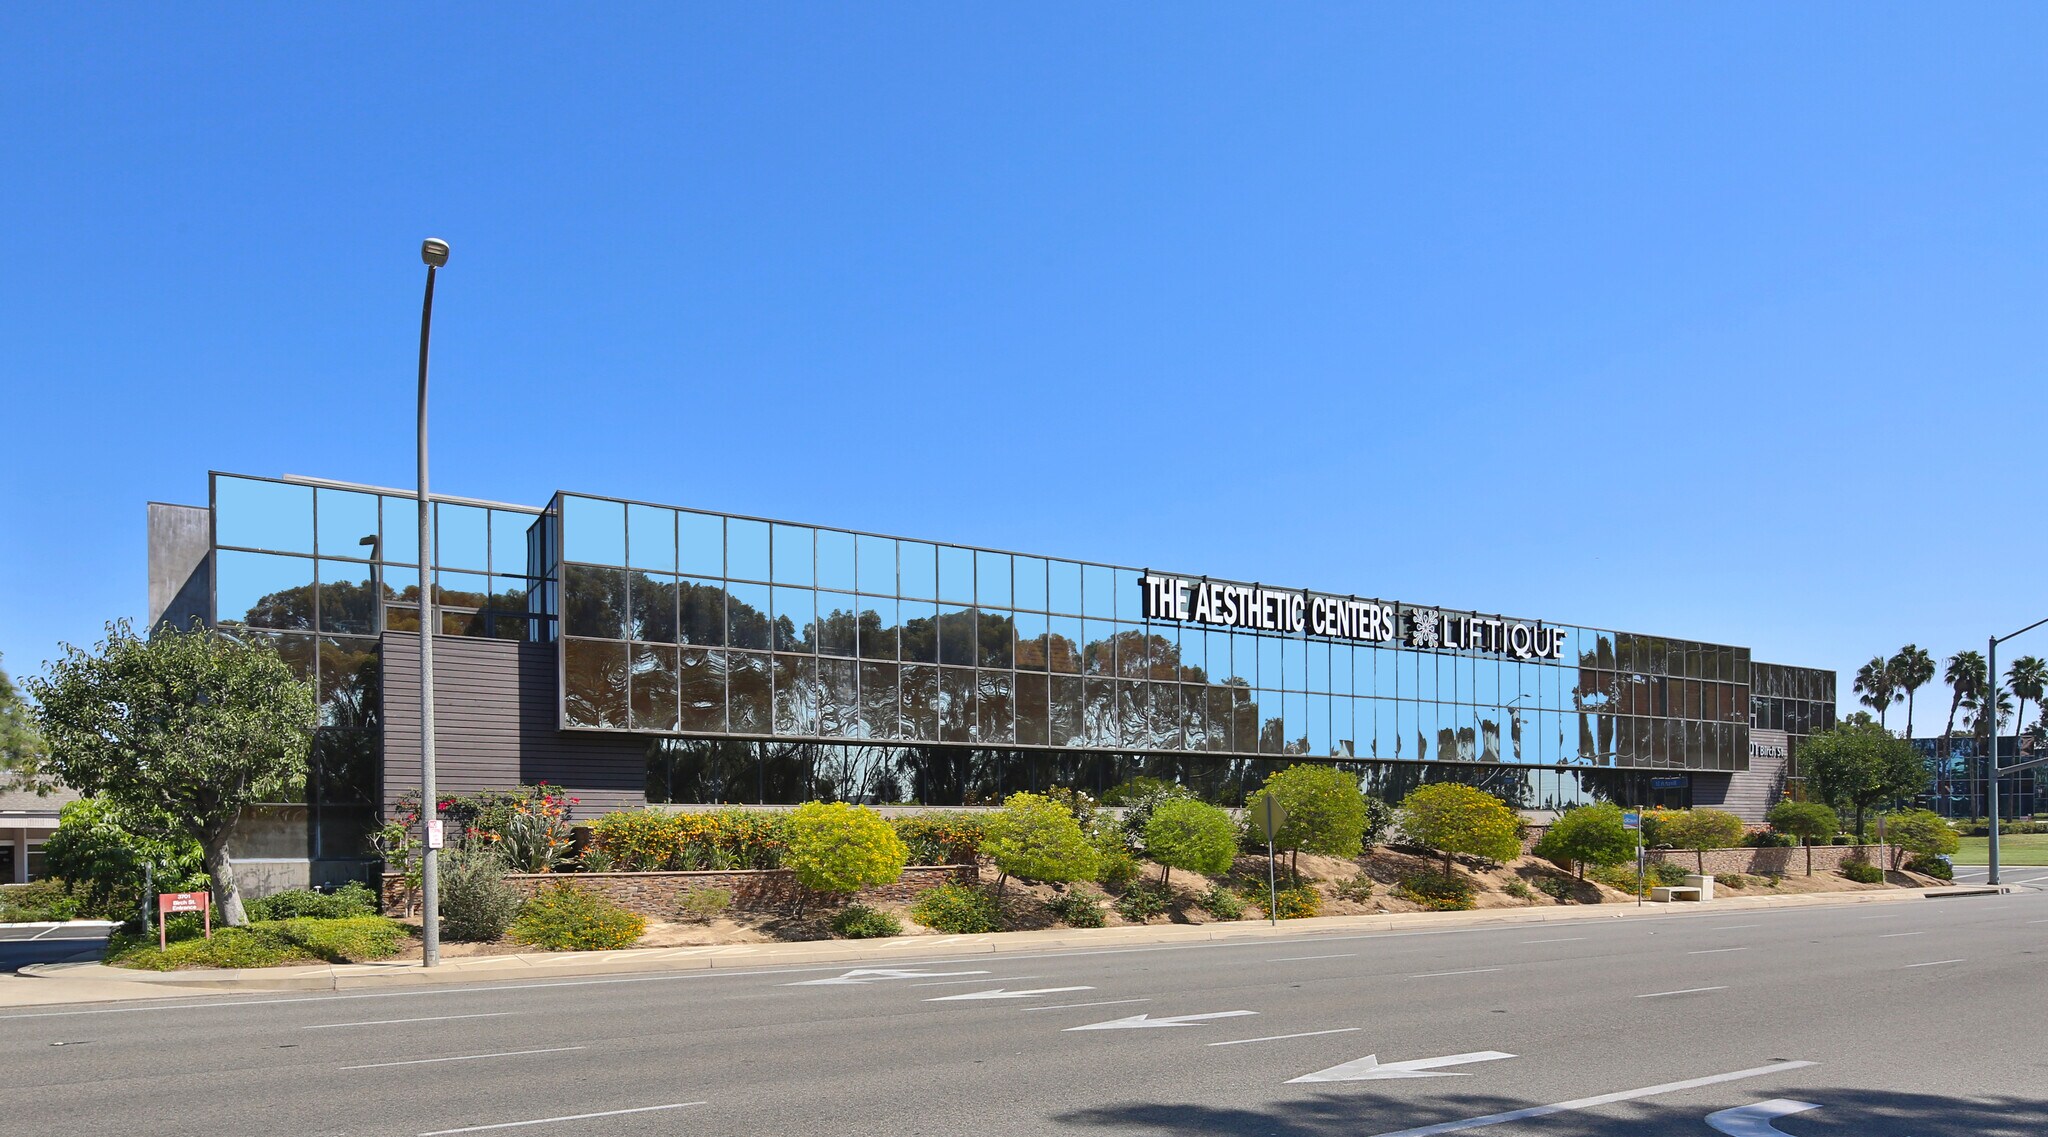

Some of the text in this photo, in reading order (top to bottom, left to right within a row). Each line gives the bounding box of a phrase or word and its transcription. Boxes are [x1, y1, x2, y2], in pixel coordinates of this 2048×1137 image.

[1146, 576, 1393, 641] THE AESTHETIC CENTERS
[1444, 615, 1565, 659] LIFTIQUE
[1760, 745, 1777, 757] Birch
